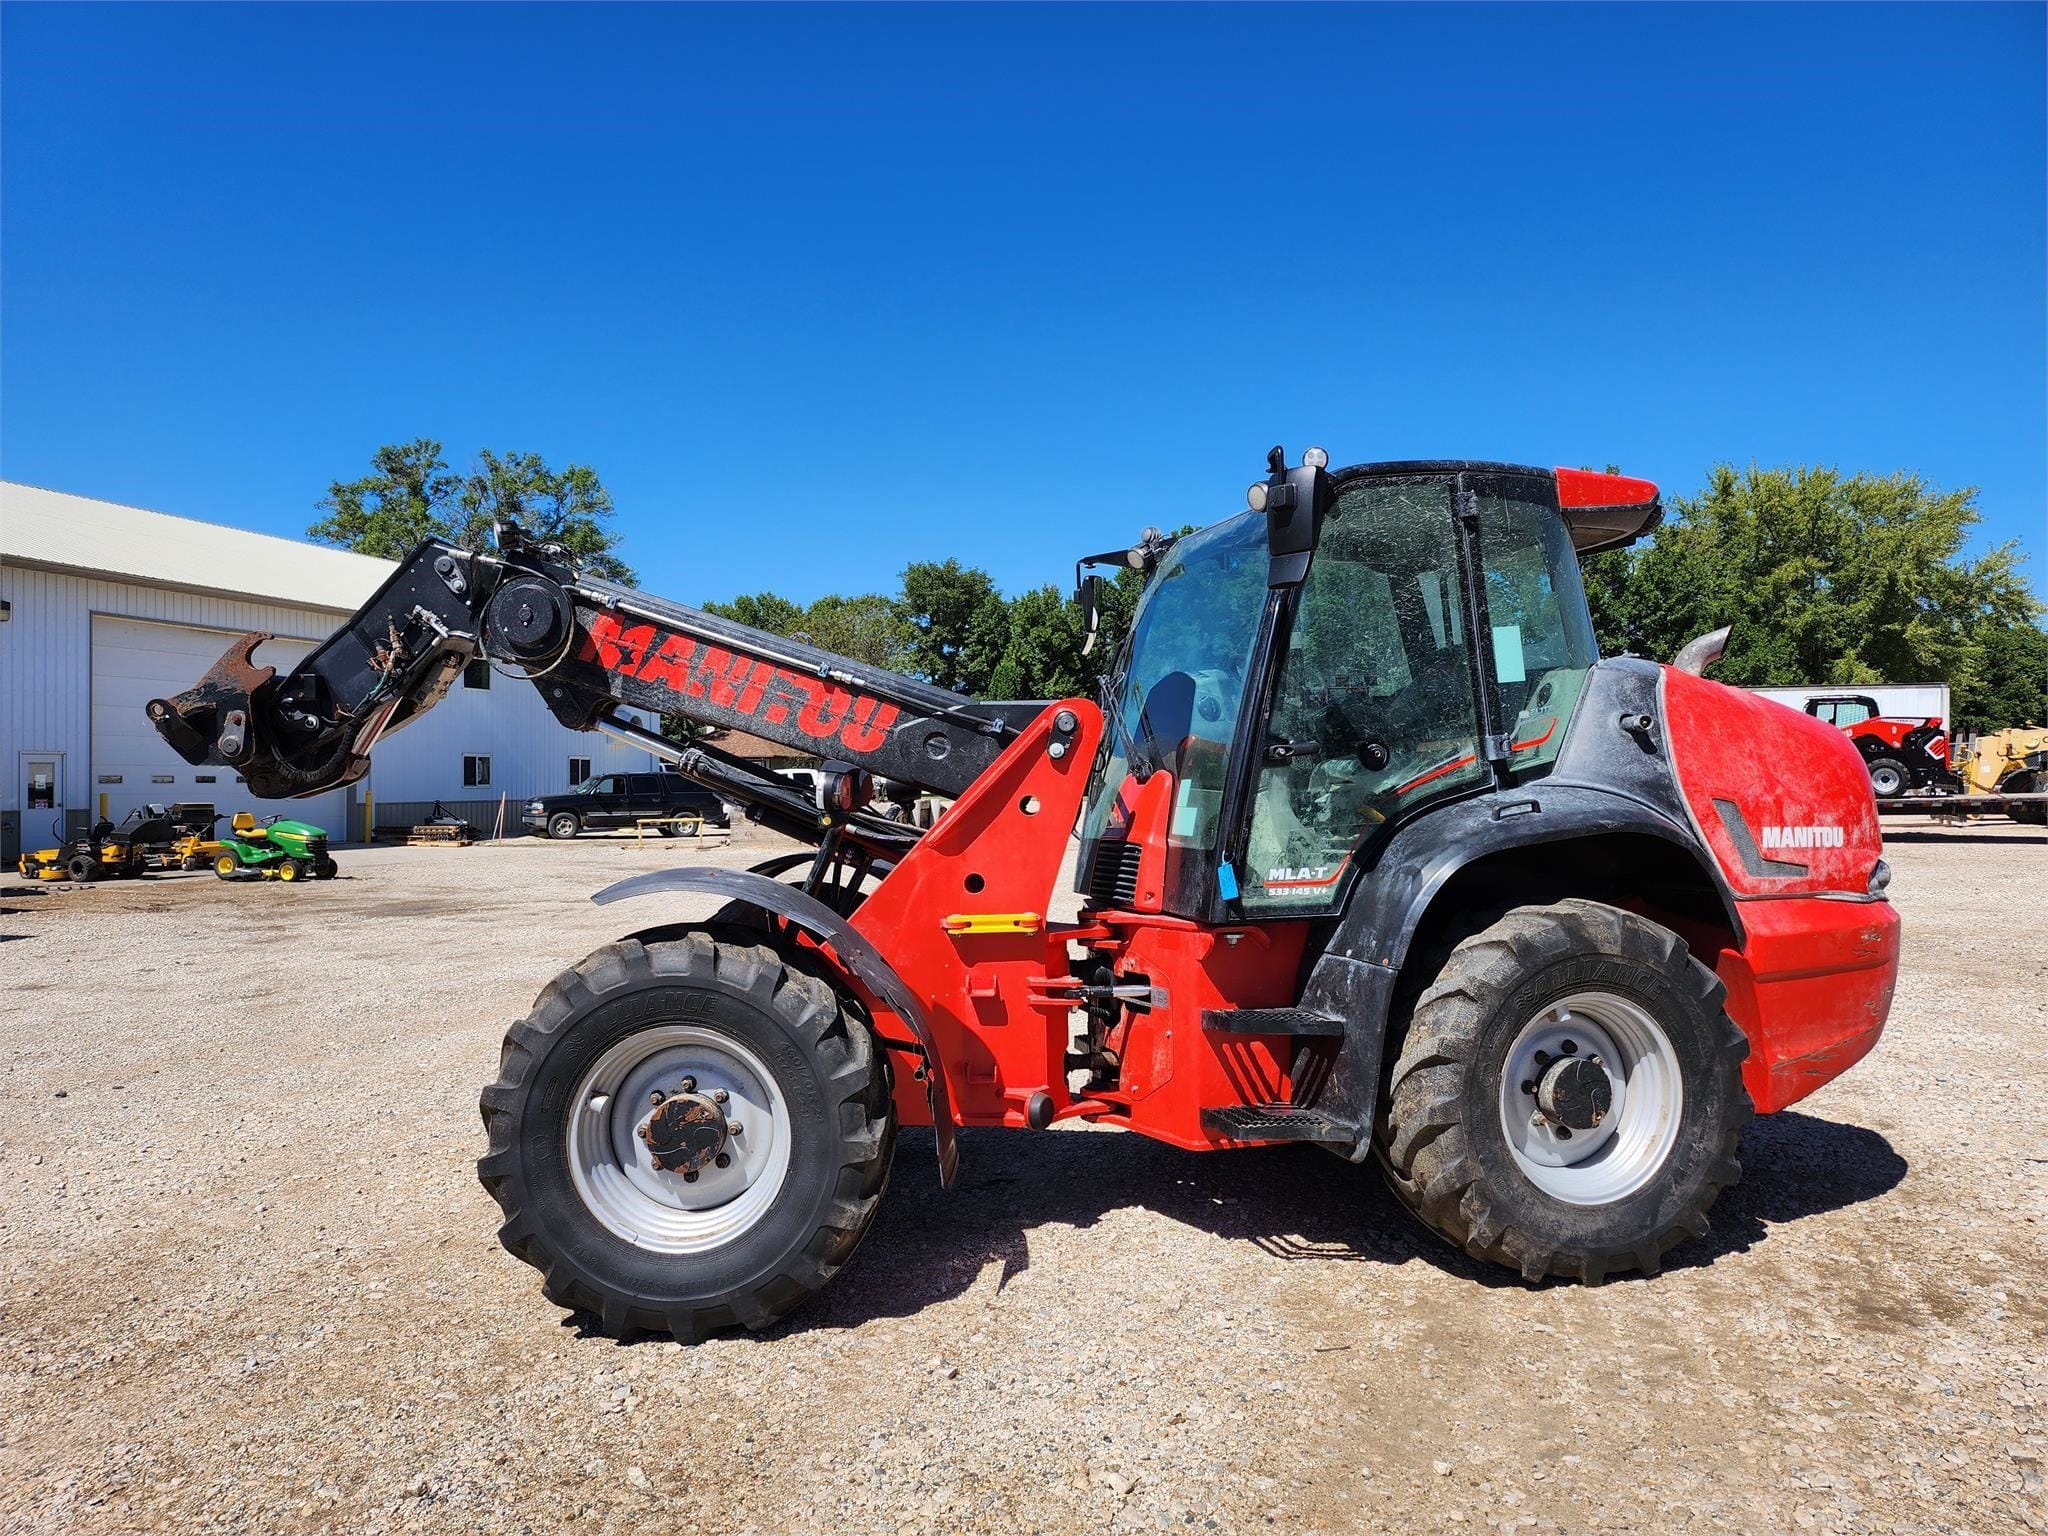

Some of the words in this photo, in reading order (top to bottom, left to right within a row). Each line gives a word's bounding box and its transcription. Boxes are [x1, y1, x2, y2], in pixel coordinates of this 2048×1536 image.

[1762, 826, 1844, 848] MANITOU
[1268, 866, 1328, 881] MLA-T
[1313, 887, 1328, 895] V+
[1533, 958, 1670, 1001] ALLIANCE
